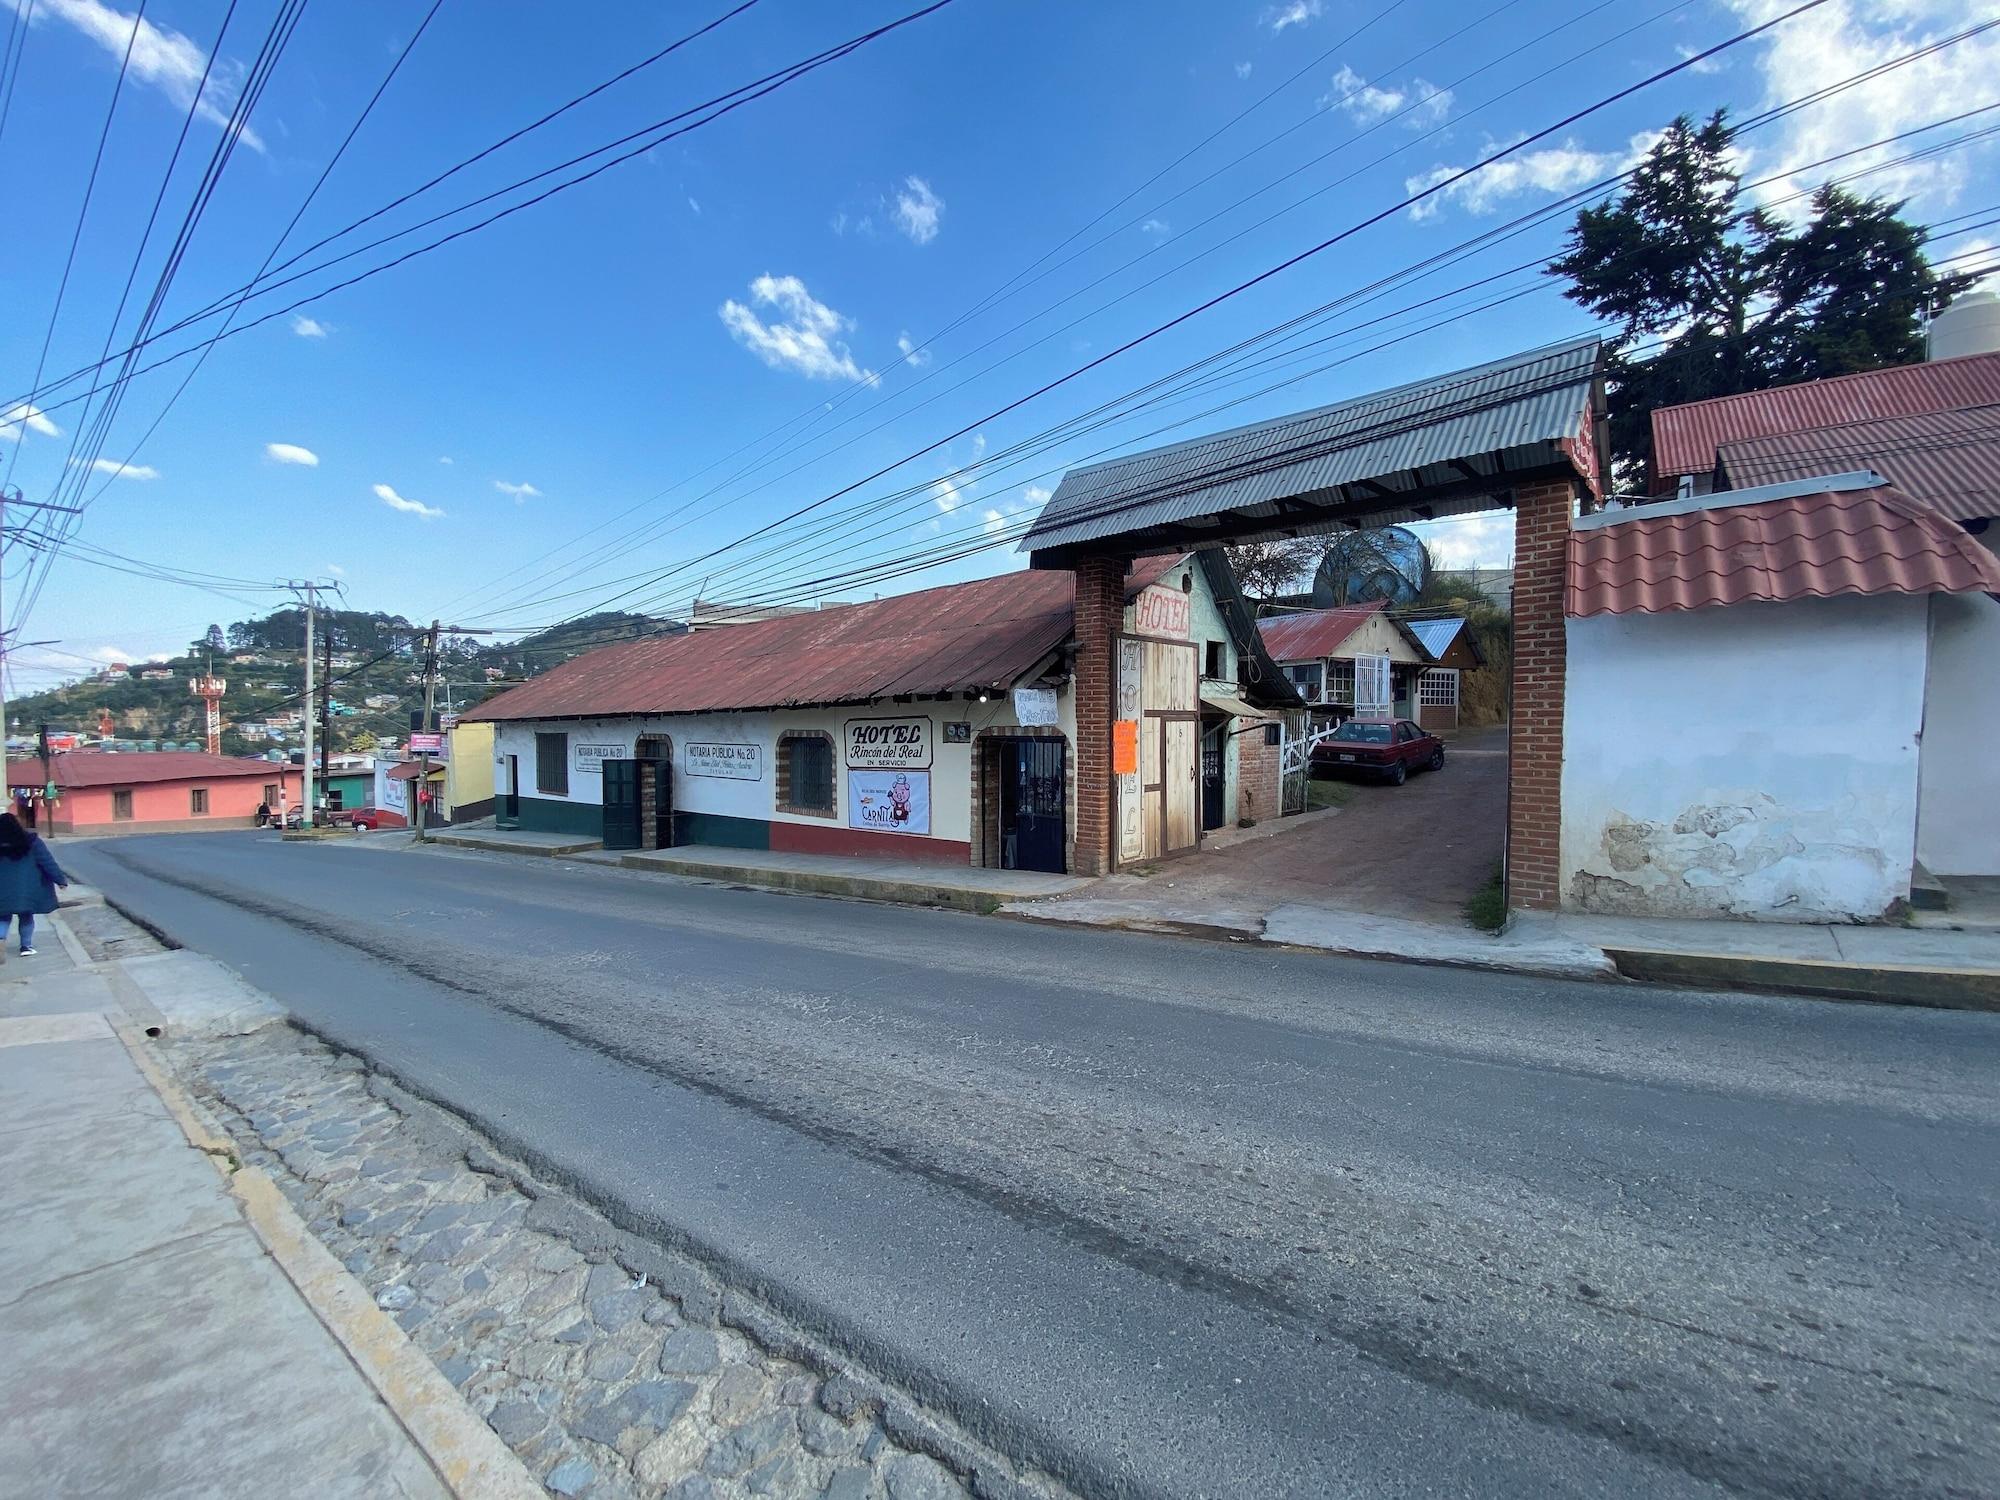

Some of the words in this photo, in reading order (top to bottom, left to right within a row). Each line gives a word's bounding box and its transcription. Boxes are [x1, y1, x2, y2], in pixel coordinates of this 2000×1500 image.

[1136, 592, 1188, 632] HOTEL
[852, 724, 921, 744] HOTEL
[1121, 642, 1139, 835] HOEL
[746, 748, 755, 760] 20
[850, 745, 882, 759] Rincón
[883, 745, 897, 758] del
[898, 744, 924, 759] Real
